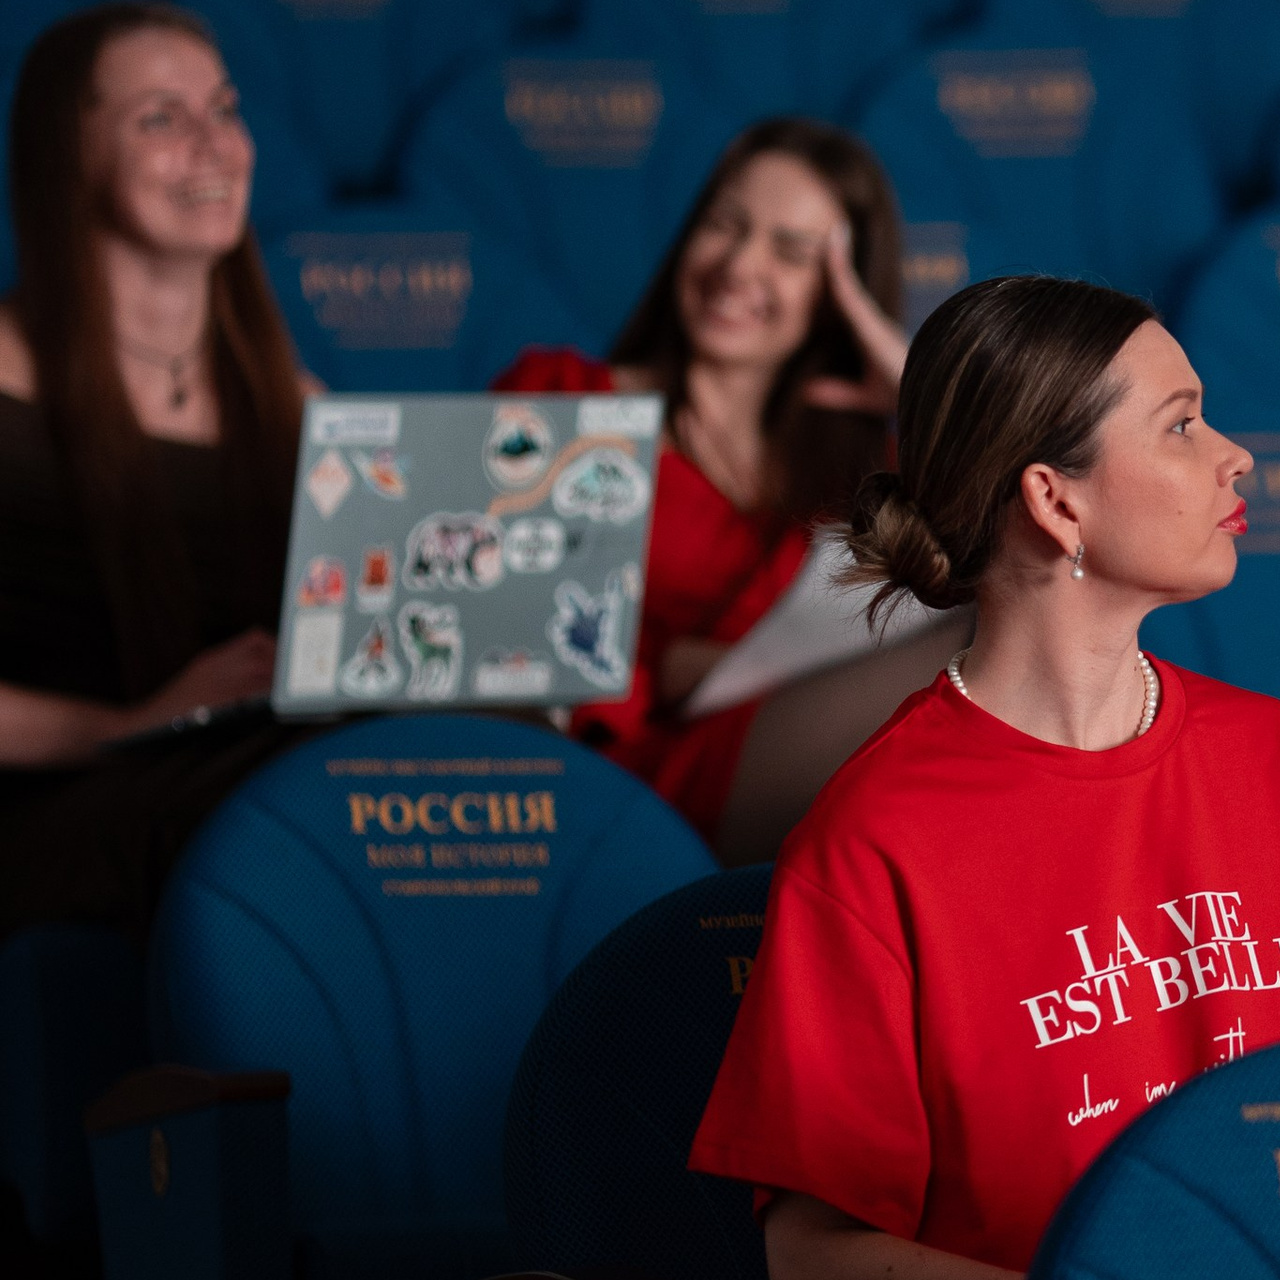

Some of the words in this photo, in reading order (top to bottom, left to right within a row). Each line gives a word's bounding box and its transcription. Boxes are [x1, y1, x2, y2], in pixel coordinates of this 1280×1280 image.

[348, 792, 557, 834] РОССИЯ
[1066, 915, 1150, 980] LA
[1157, 891, 1251, 947] VIE
[1020, 970, 1132, 1049] EST
[1068, 1073, 1119, 1126] when
